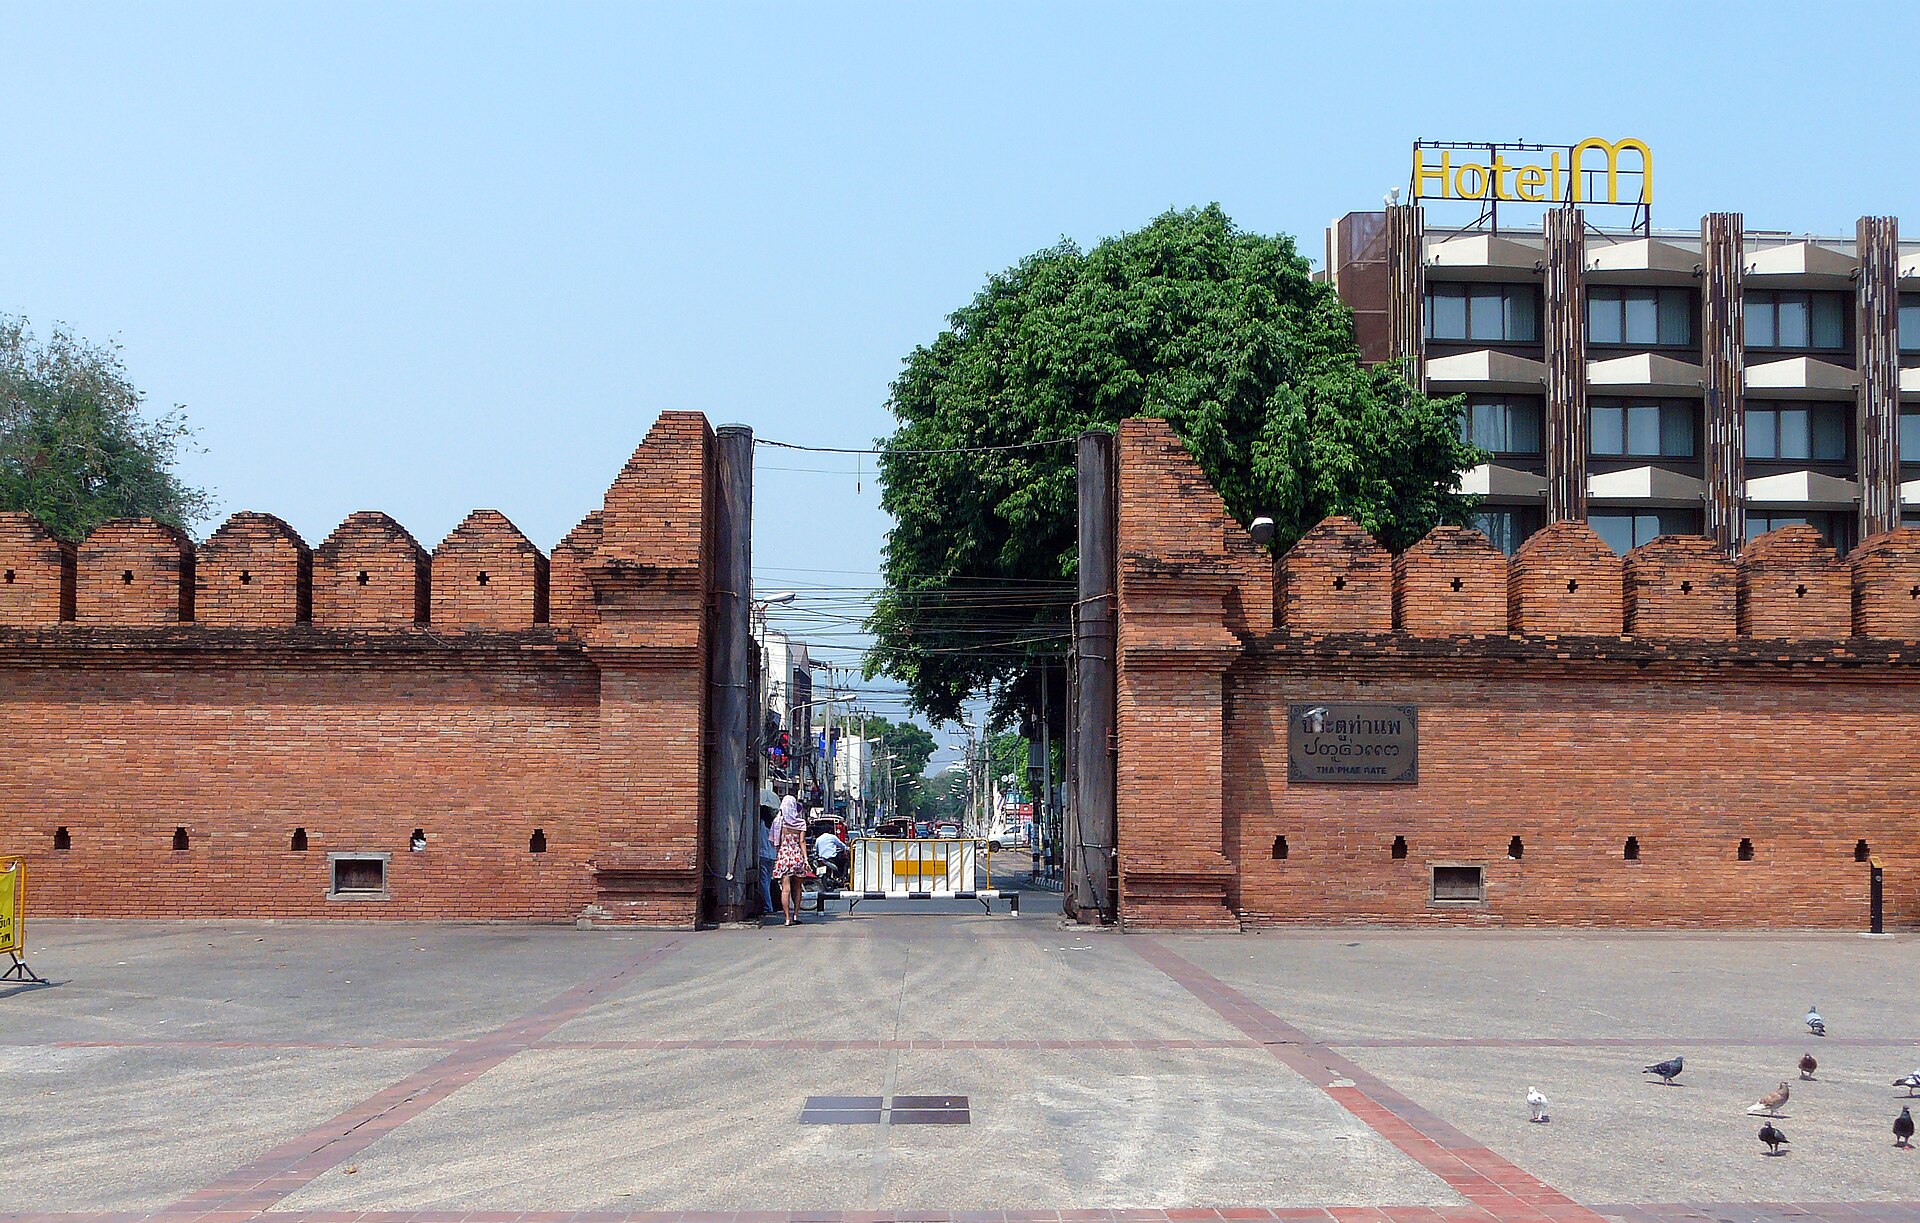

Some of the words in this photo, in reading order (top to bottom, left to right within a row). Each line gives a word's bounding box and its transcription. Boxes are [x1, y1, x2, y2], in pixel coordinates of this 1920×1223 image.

[1414, 149, 1560, 203] Hotel
[1316, 766, 1335, 774] THA
[1337, 766, 1361, 775] PHAE
[1363, 766, 1388, 775] GATE
